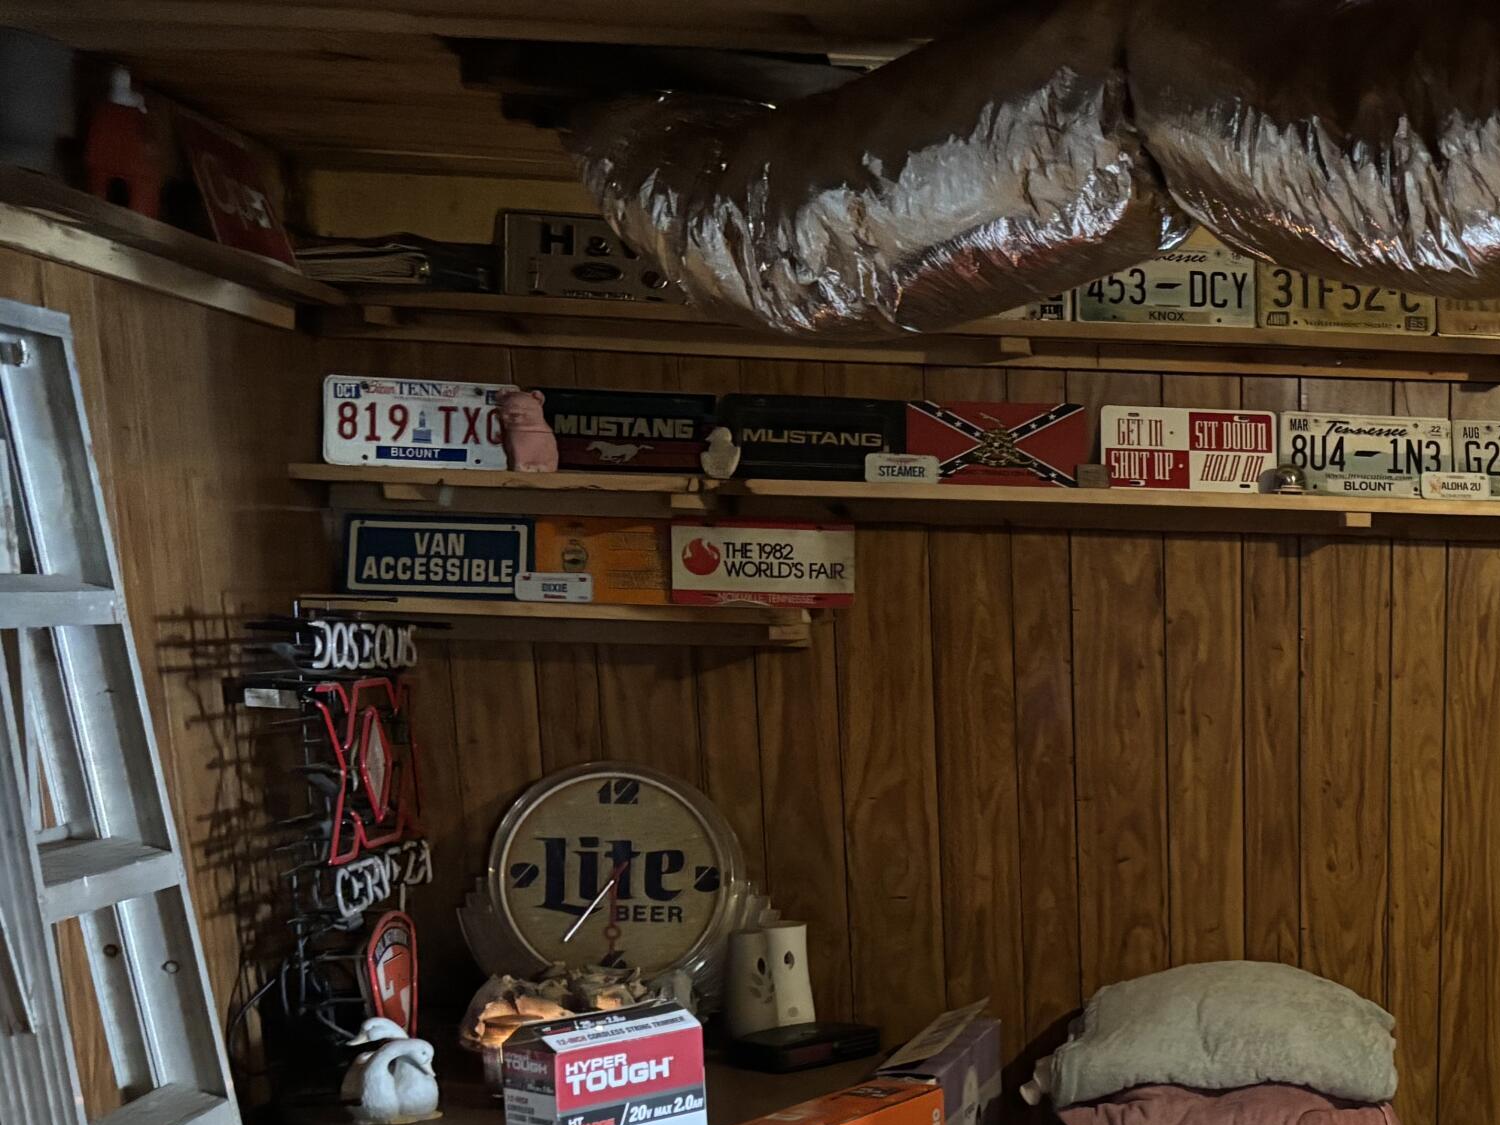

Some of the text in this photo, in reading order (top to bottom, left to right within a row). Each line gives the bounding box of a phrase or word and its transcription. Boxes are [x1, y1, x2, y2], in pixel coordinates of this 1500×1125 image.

[1087, 268, 1248, 309] 453 DCY
[1149, 310, 1186, 322] KNOX
[336, 383, 357, 399] OCT
[337, 400, 409, 443] 819
[554, 413, 694, 440] MUSTANG
[1117, 417, 1164, 447] GET IN
[1290, 418, 1309, 432] MAR
[1325, 420, 1409, 437] Tennessee
[1430, 425, 1441, 433] 22
[741, 427, 884, 448] MUSTANG
[1194, 420, 1268, 451] SIT DOWN
[1462, 426, 1480, 440] AUG
[390, 447, 441, 460] BLOUNT
[1291, 434, 1441, 474] 8U4 1N3
[878, 464, 926, 479] STEAMER
[1110, 450, 1174, 481] SHUT UP
[1200, 453, 1265, 483] HOLD ON
[1343, 480, 1394, 492] BLOUNT
[1441, 481, 1481, 491] ALOHA 2U
[413, 531, 465, 556] VAN
[723, 541, 794, 561] THE 1982
[361, 556, 514, 583] ACCESSIBLE
[723, 560, 845, 580] WORLD'S FAIR
[597, 779, 640, 805] 12
[532, 836, 685, 917] Lite
[614, 904, 684, 923] BEER
[565, 1053, 628, 1077] HYPER
[565, 1058, 671, 1096] TOUGH
[628, 1104, 653, 1123] 20V
